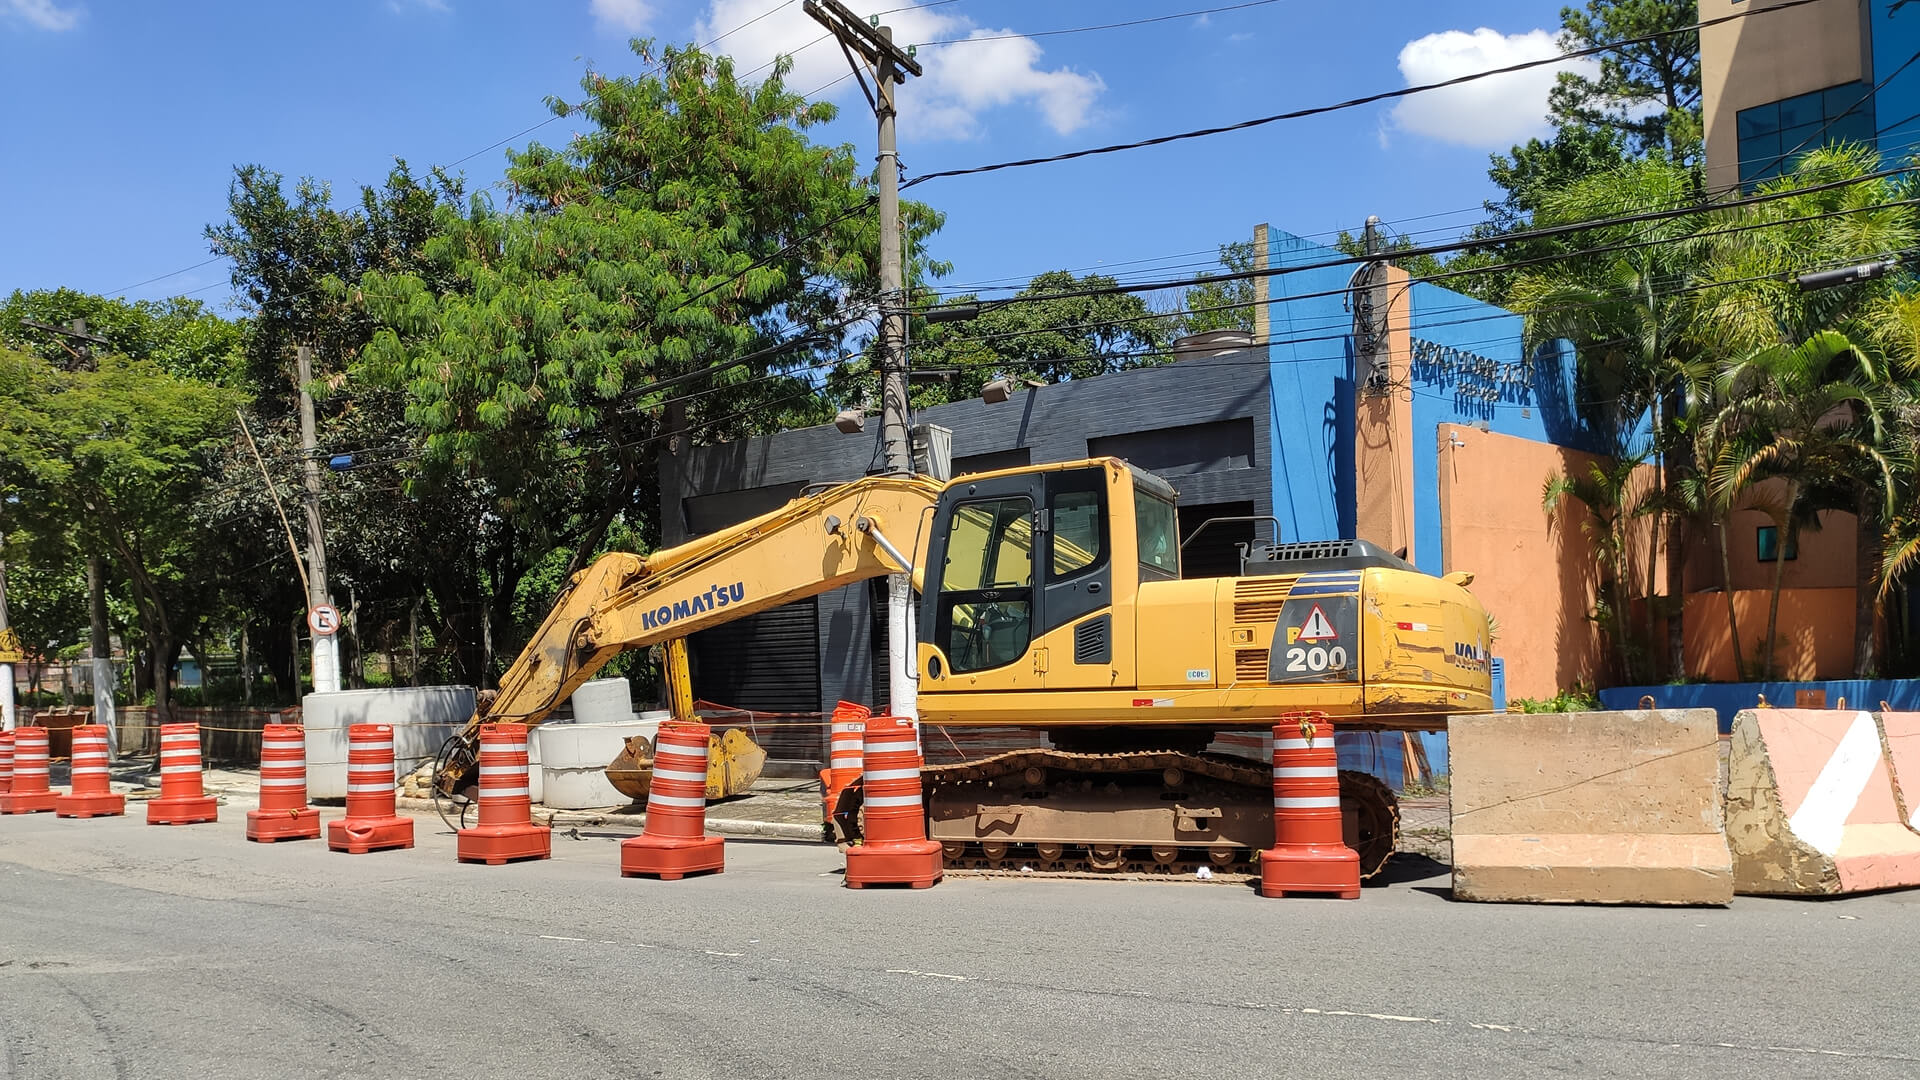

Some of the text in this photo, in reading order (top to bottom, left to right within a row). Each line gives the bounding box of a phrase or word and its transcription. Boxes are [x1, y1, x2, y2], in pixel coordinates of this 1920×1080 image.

[642, 581, 745, 631] KOMATSU
[319, 611, 330, 628] E
[1286, 646, 1347, 672] 200
